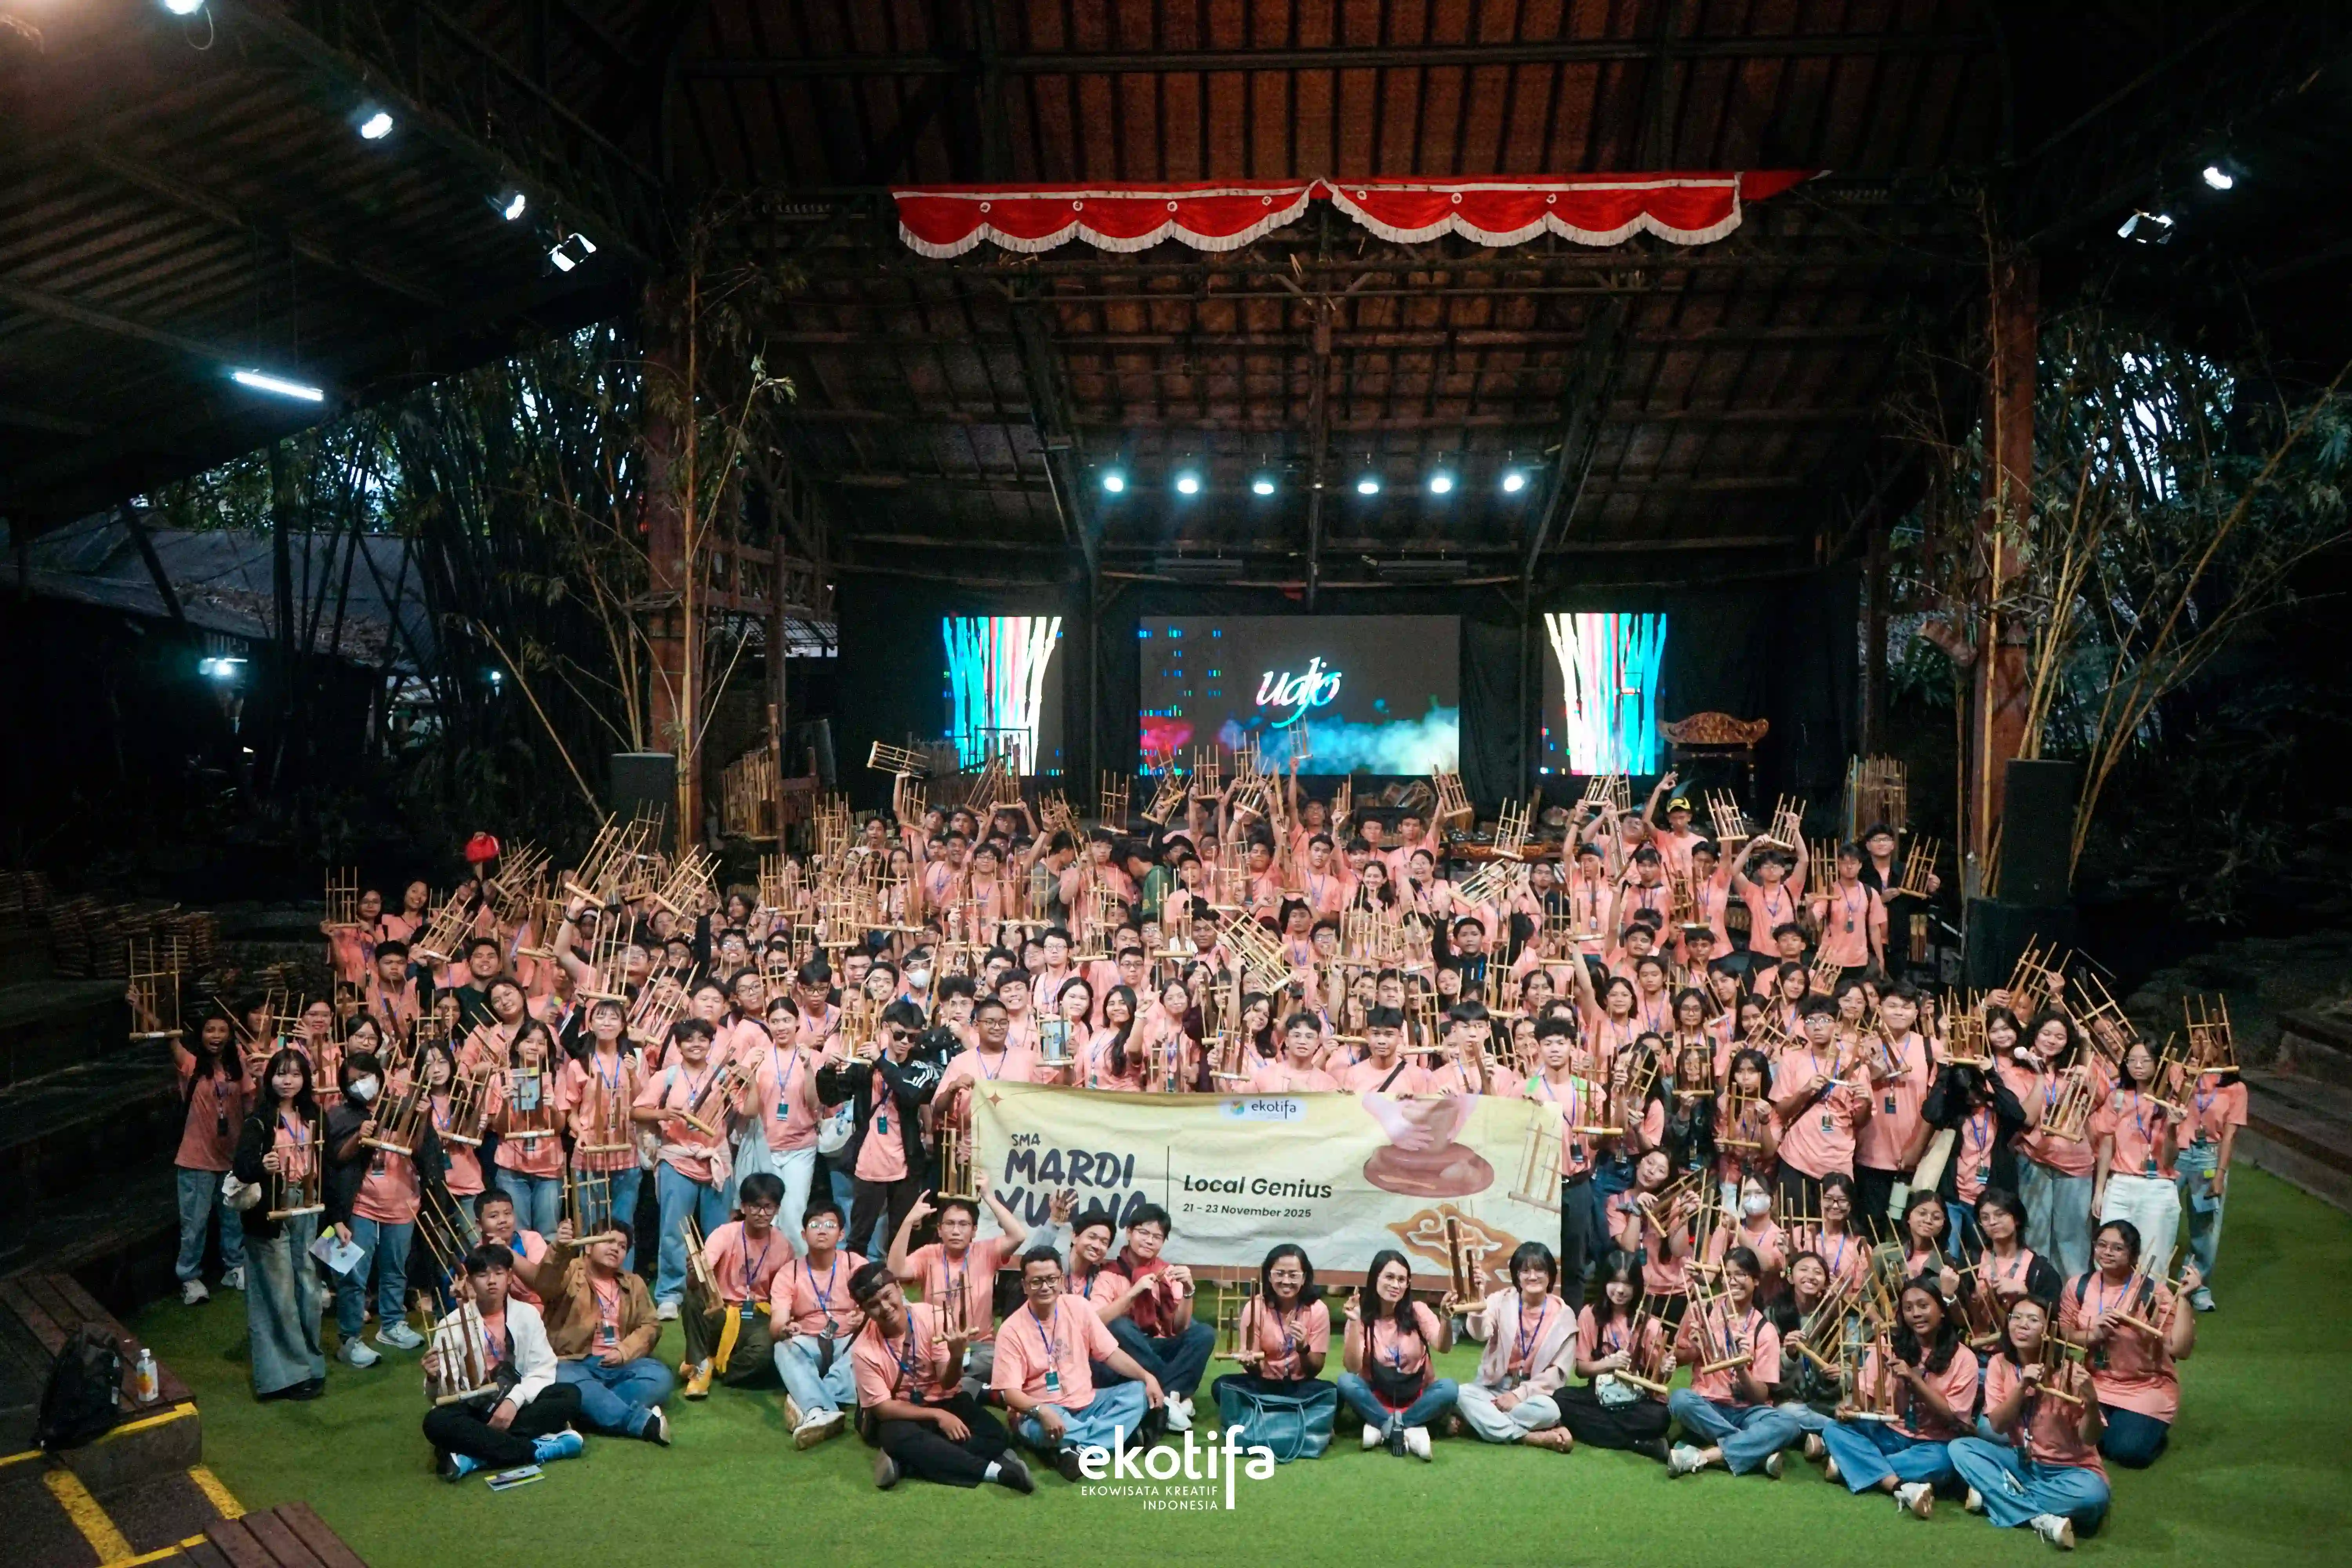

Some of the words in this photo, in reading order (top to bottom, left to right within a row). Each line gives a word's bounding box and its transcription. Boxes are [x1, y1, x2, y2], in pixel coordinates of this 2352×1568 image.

[1251, 1099, 1296, 1119] ekotifa
[1011, 1133, 1041, 1147] SMA
[1004, 1148, 1135, 1189] MARDI
[1184, 1175, 1246, 1194] Local
[1251, 1178, 1332, 1199] Genius
[1183, 1203, 1194, 1212] 21
[1205, 1204, 1218, 1213] 23
[1221, 1205, 1282, 1217] November
[1284, 1209, 1312, 1218] 2025
